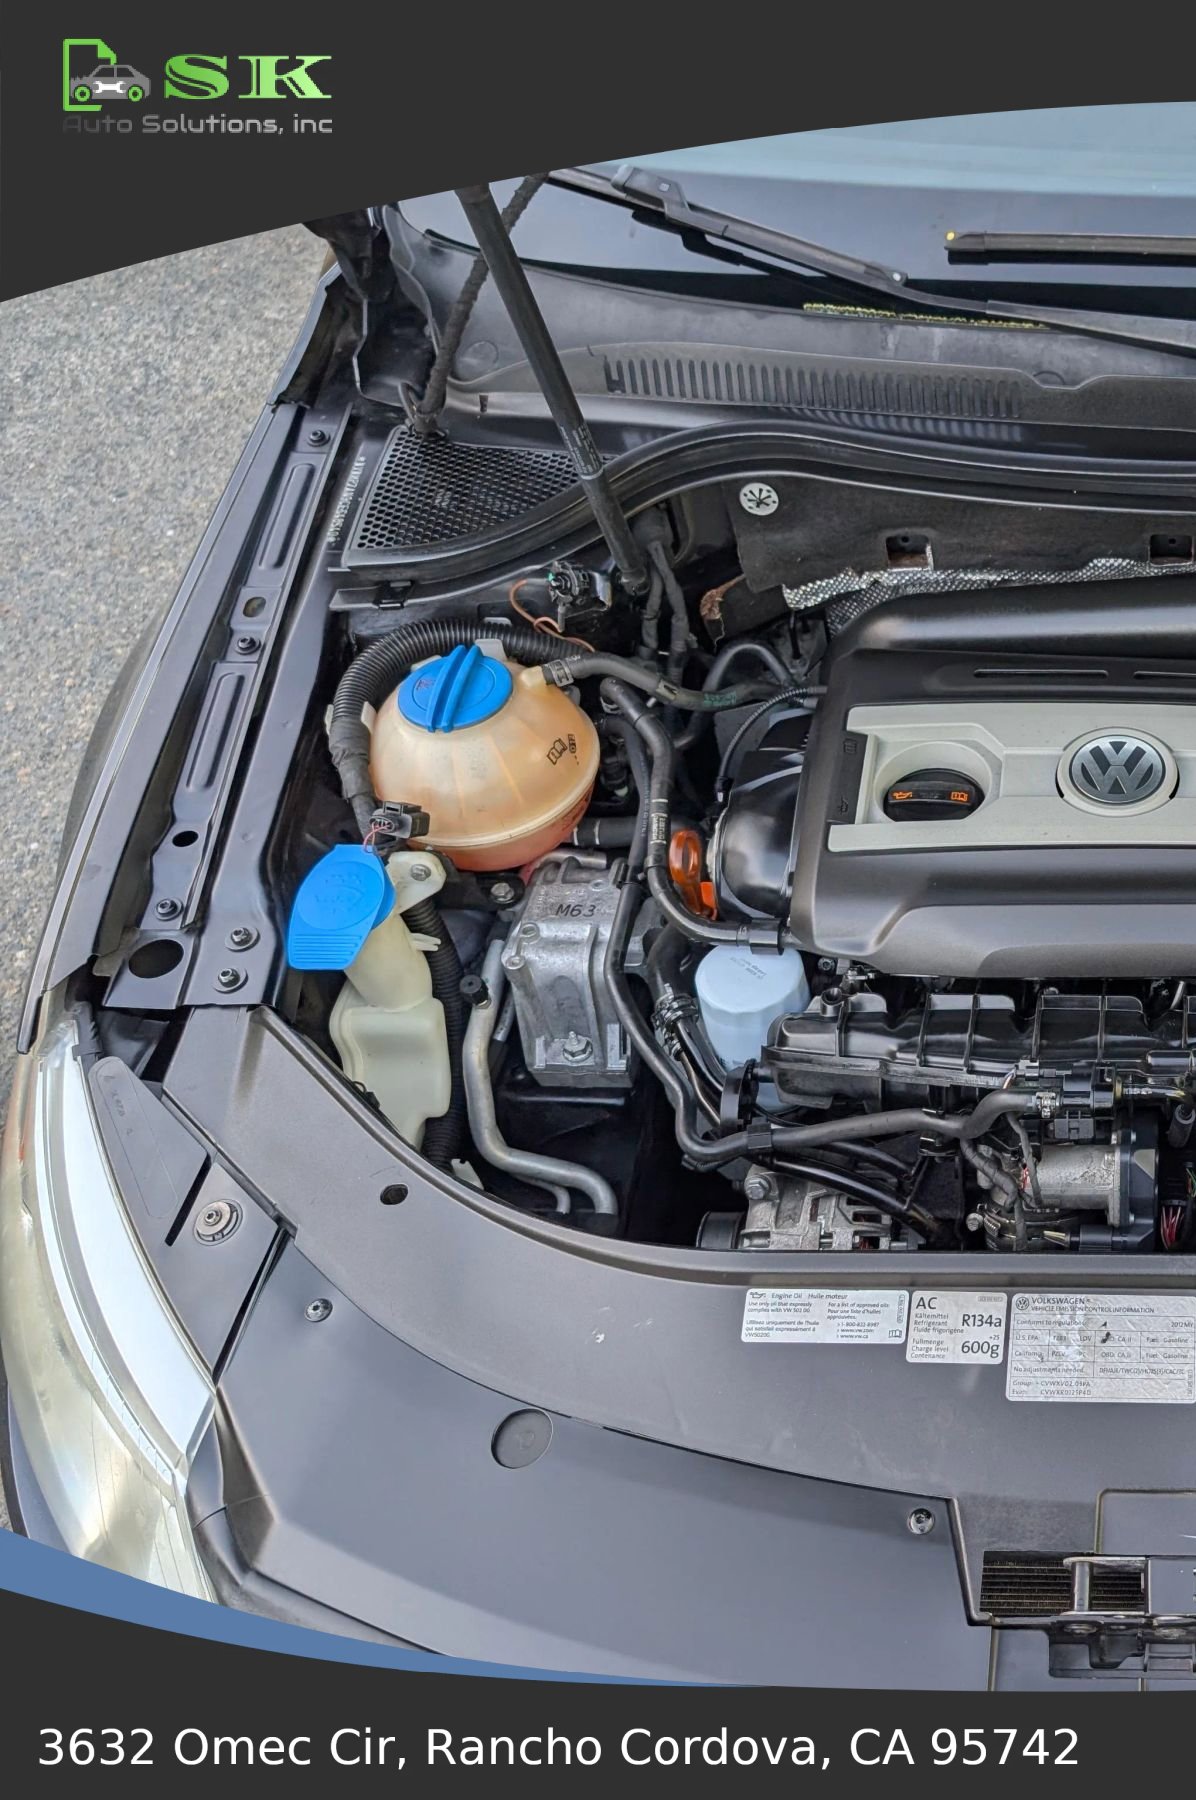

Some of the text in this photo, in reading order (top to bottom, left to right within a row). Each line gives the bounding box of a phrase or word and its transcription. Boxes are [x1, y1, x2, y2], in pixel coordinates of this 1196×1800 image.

[556, 904, 596, 917] M63
[771, 1292, 792, 1300] Engine
[1032, 1297, 1084, 1305] VOLKSWAGEN
[916, 1297, 937, 1309] AC
[962, 1314, 1002, 1327] R134a
[961, 1341, 1000, 1358] 600g
